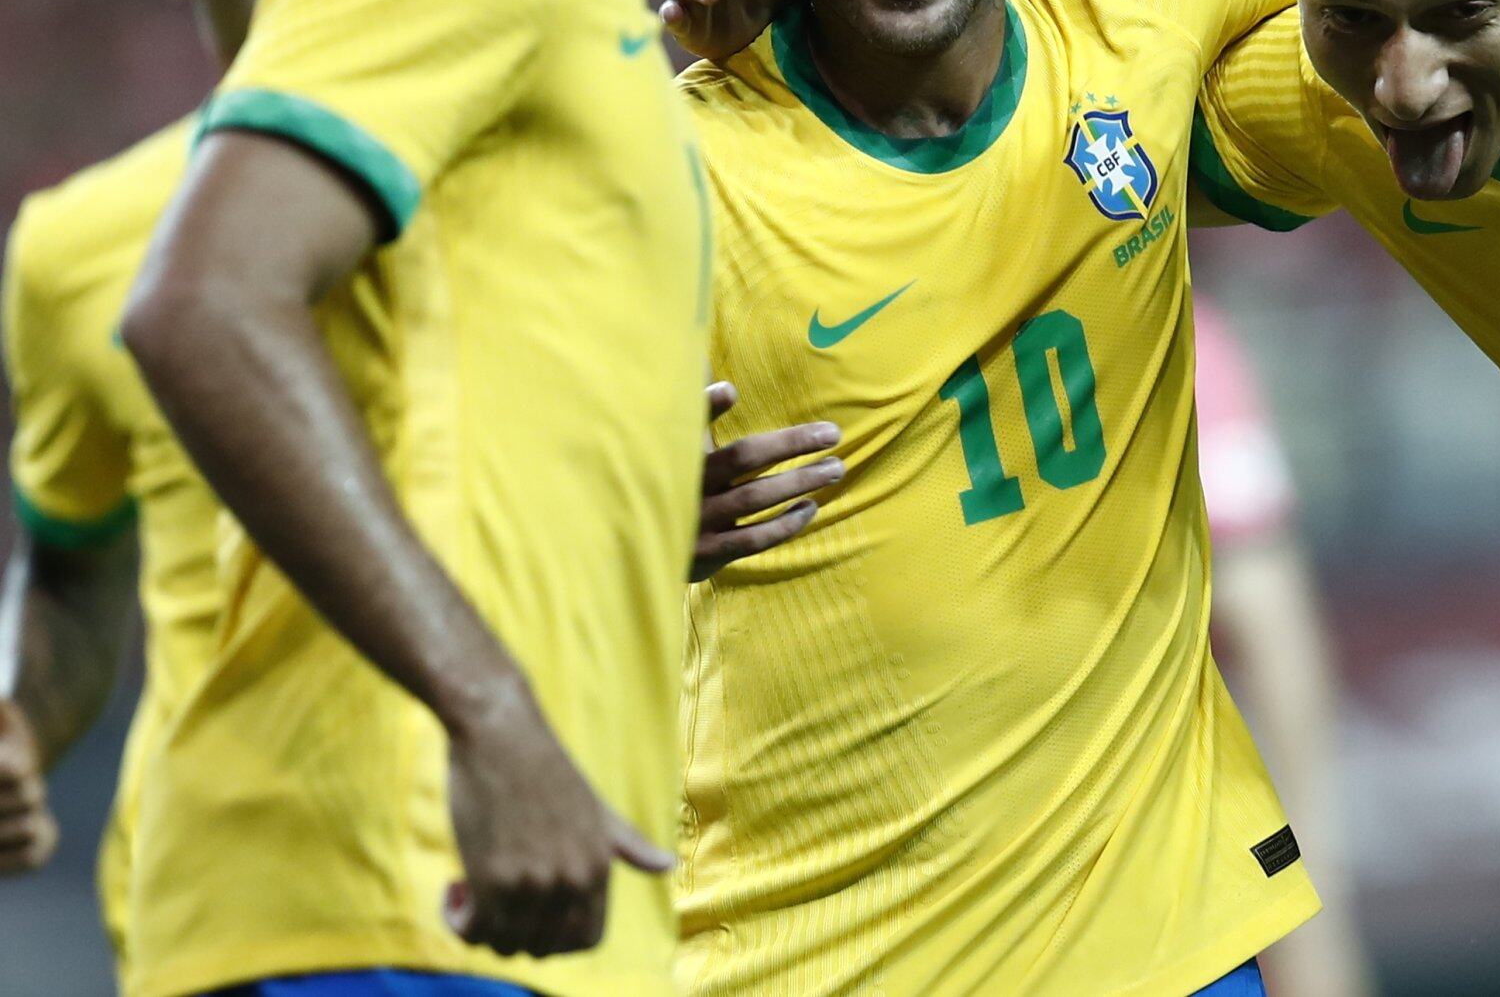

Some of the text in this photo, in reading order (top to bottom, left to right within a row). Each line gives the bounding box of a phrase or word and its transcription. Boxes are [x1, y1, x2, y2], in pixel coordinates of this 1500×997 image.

[1096, 151, 1122, 178] CBF
[1112, 205, 1176, 268] BRASIL
[938, 308, 1107, 526] 10
